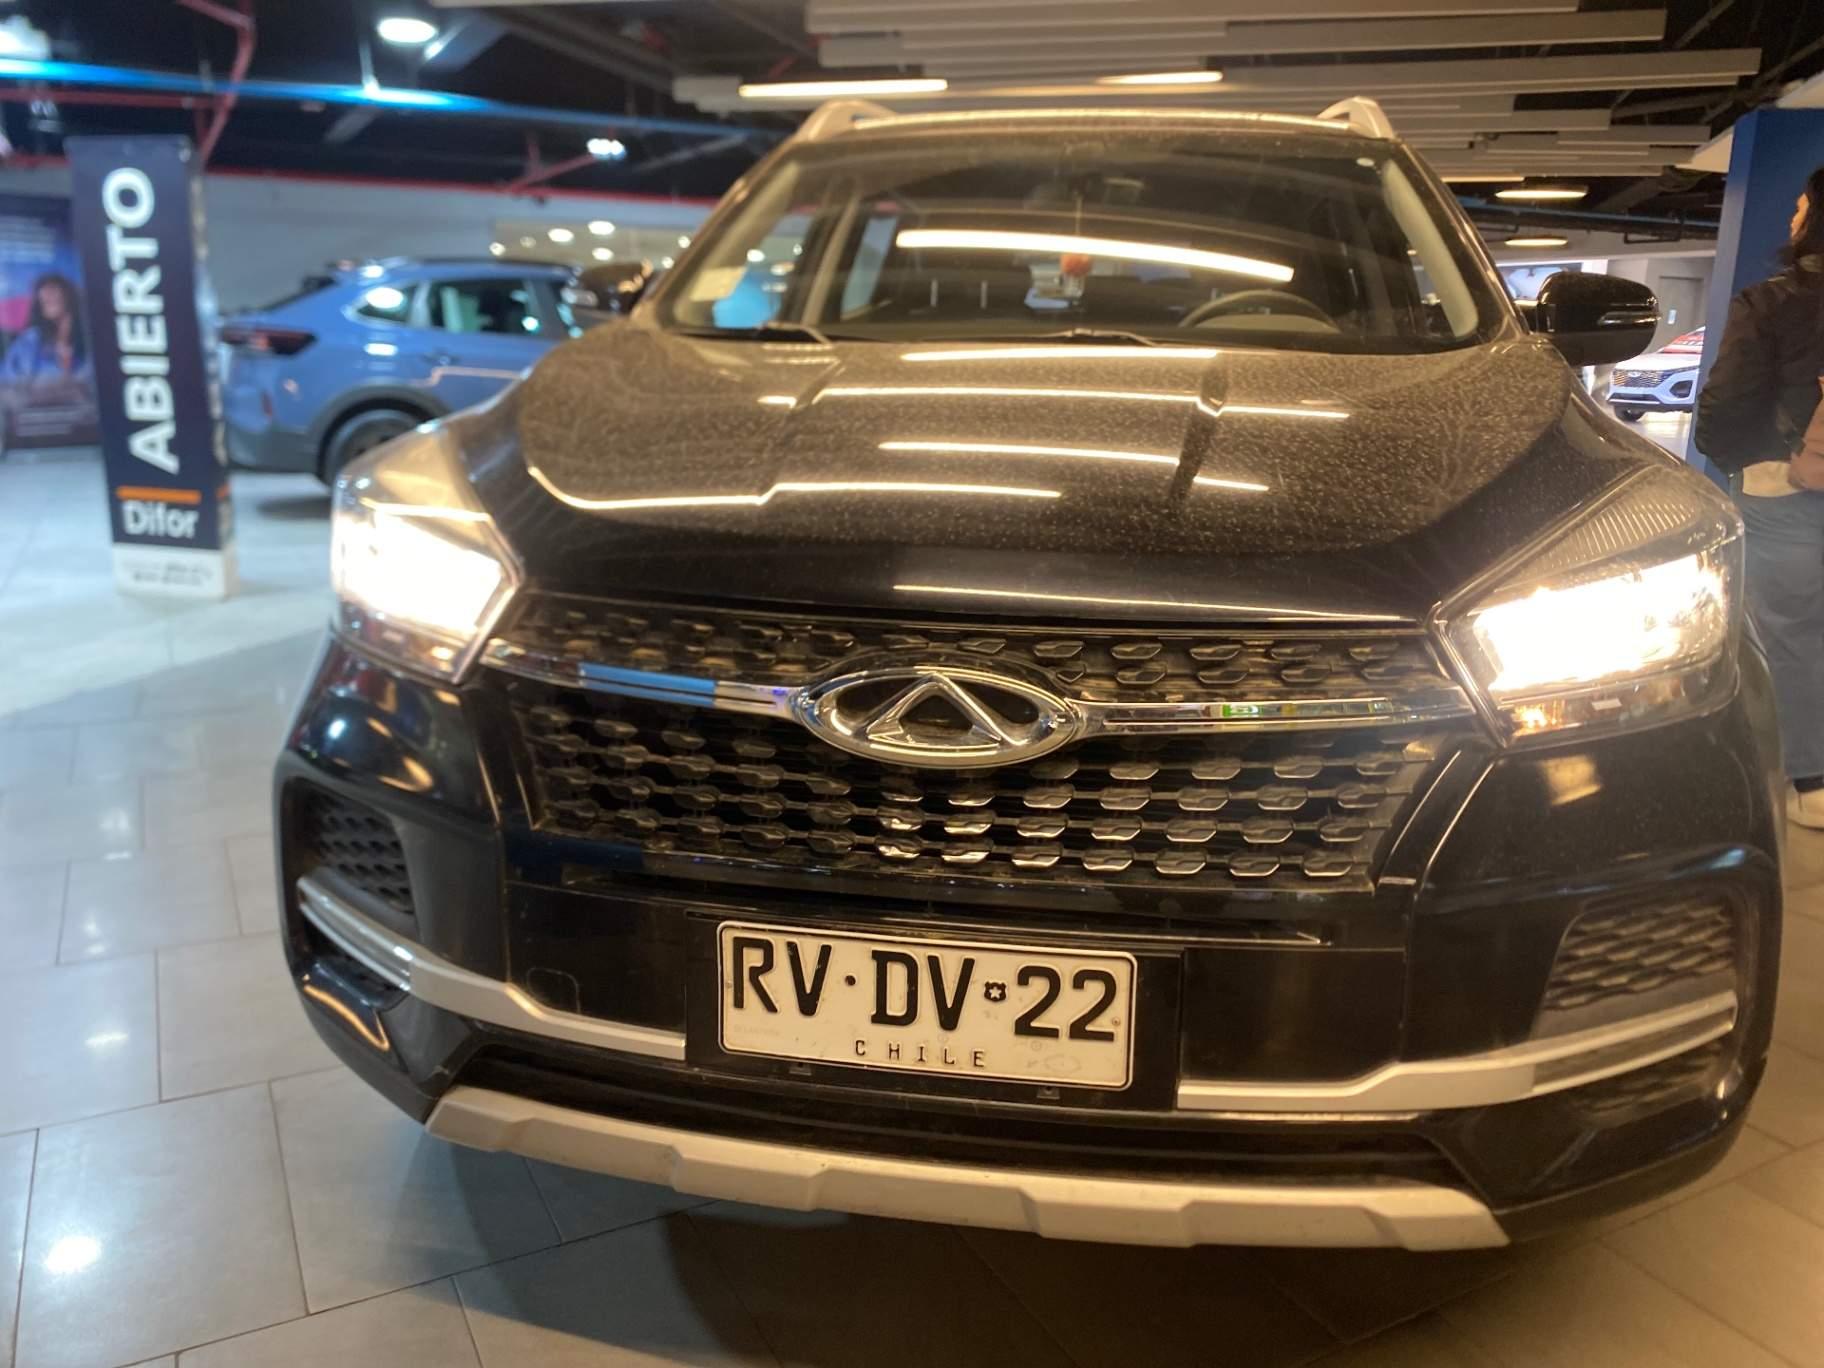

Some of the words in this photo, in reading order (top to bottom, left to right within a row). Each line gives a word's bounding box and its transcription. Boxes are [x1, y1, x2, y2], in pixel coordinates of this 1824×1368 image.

[102, 167, 179, 475] ABIERTO
[123, 501, 199, 539] Difor
[854, 1039, 986, 1068] CHILE
